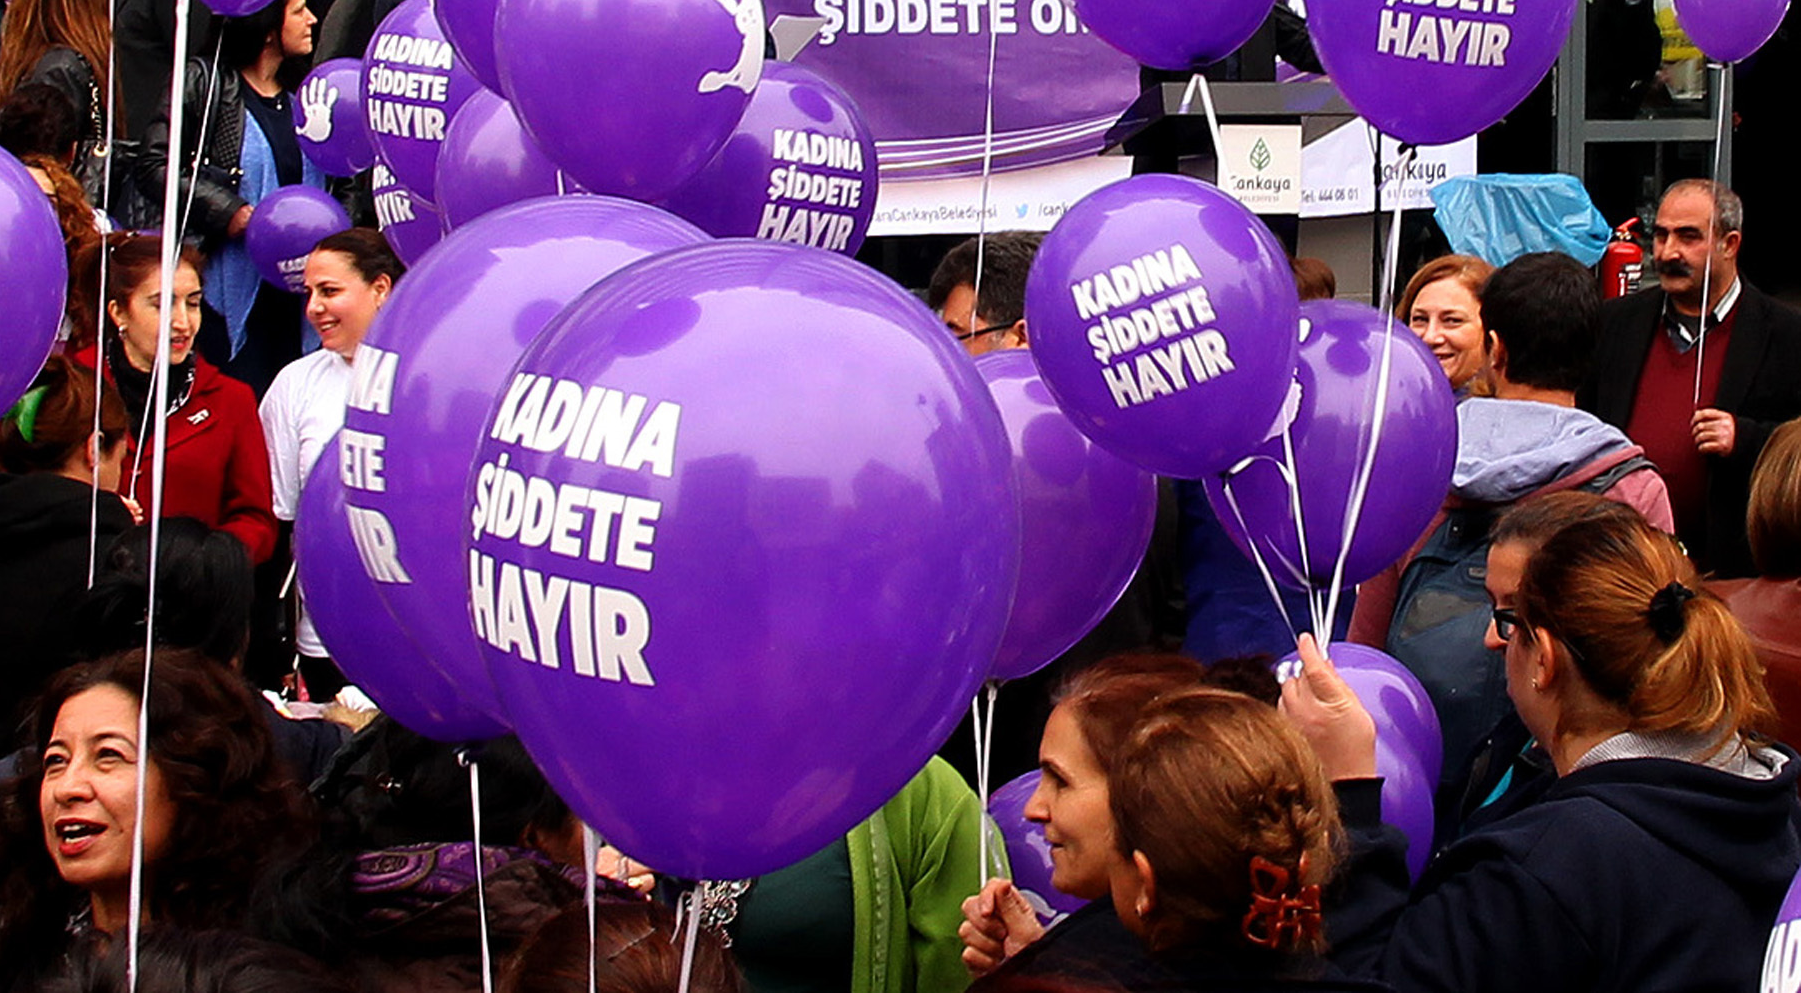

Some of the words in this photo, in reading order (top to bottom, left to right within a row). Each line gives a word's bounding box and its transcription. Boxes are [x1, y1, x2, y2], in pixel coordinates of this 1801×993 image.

[373, 34, 453, 70] KADINA
[1377, 9, 1511, 67] HAYIR
[368, 63, 449, 102] ŞİDDETE
[367, 98, 446, 141] HAYIR
[772, 129, 863, 172] KADINA
[767, 164, 862, 208] ŞİDDETE
[756, 203, 854, 251] HAYIR
[1071, 243, 1203, 321] KADINA
[1087, 285, 1217, 365] ŞİDDETE
[1101, 328, 1236, 409] HAYIR
[490, 372, 682, 479] KADINA
[471, 453, 662, 572] ŞİDDETE
[469, 548, 656, 687] HAYIR
